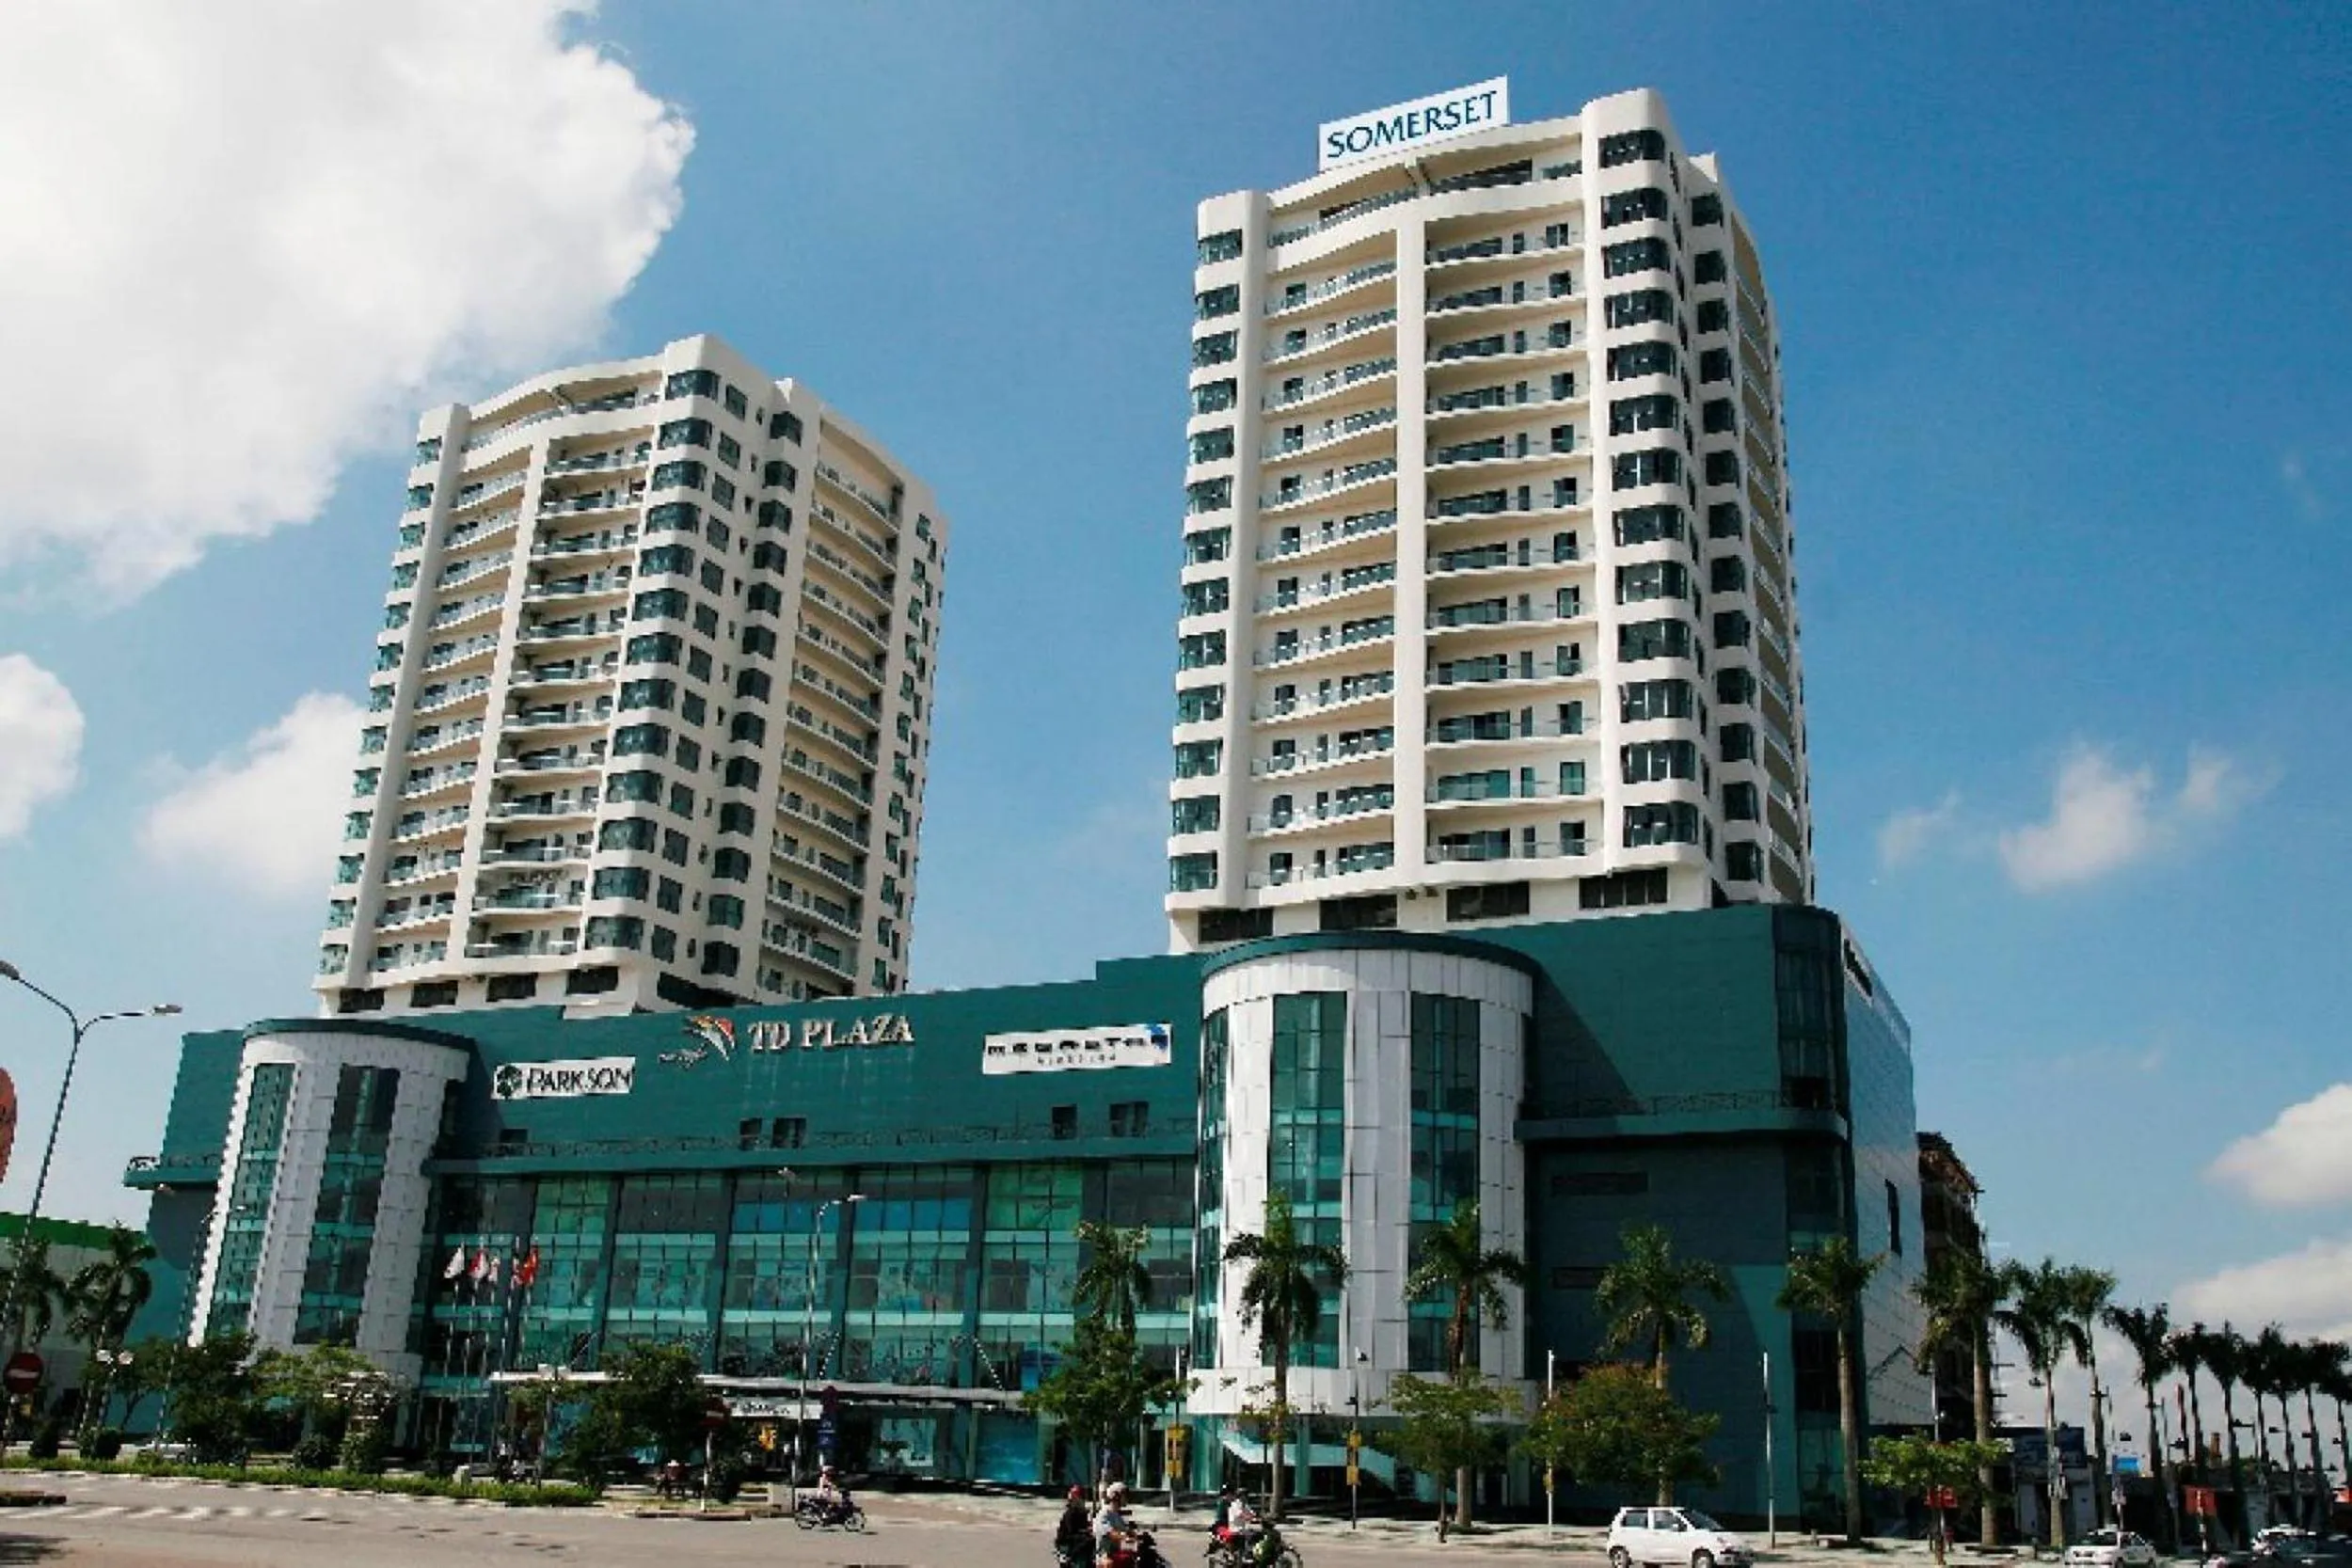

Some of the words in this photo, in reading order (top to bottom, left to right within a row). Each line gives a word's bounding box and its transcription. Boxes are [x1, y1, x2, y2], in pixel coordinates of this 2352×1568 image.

[1327, 90, 1498, 158] SOMERSET
[747, 1020, 791, 1052] TD
[801, 1013, 914, 1048] PLAZA
[526, 1066, 631, 1094] PARKSON
